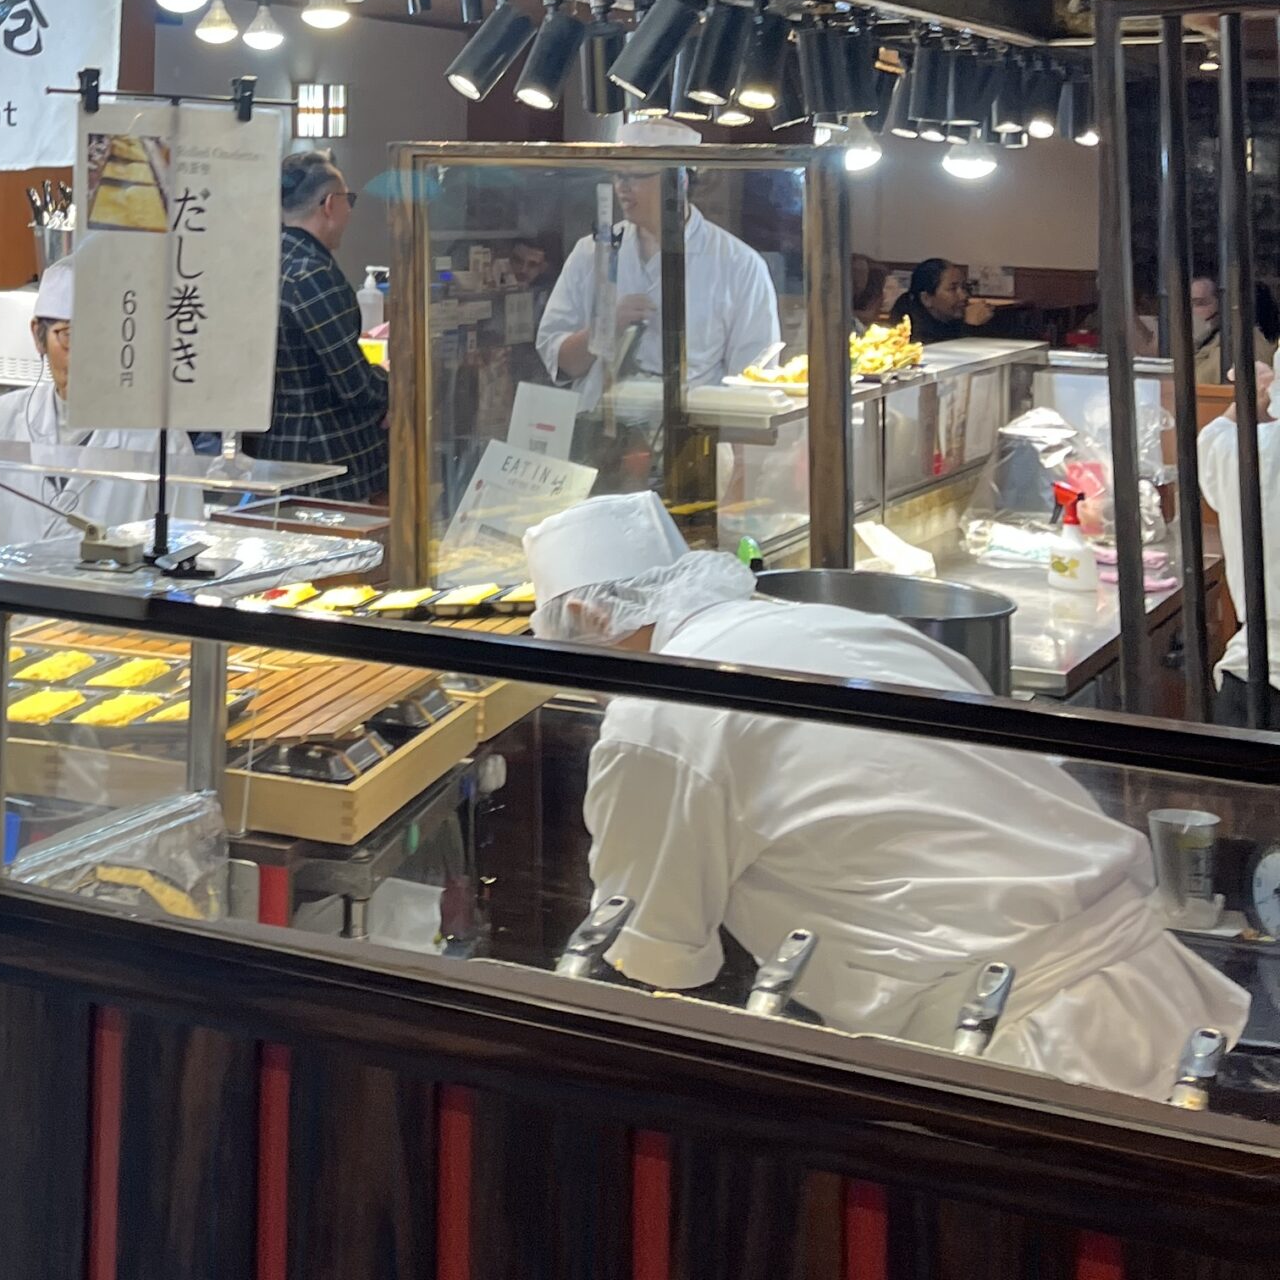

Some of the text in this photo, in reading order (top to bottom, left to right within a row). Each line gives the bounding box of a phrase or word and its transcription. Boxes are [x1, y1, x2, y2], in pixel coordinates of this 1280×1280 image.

[166, 186, 209, 384] だし巻き
[500, 455, 553, 483] EAT IN
